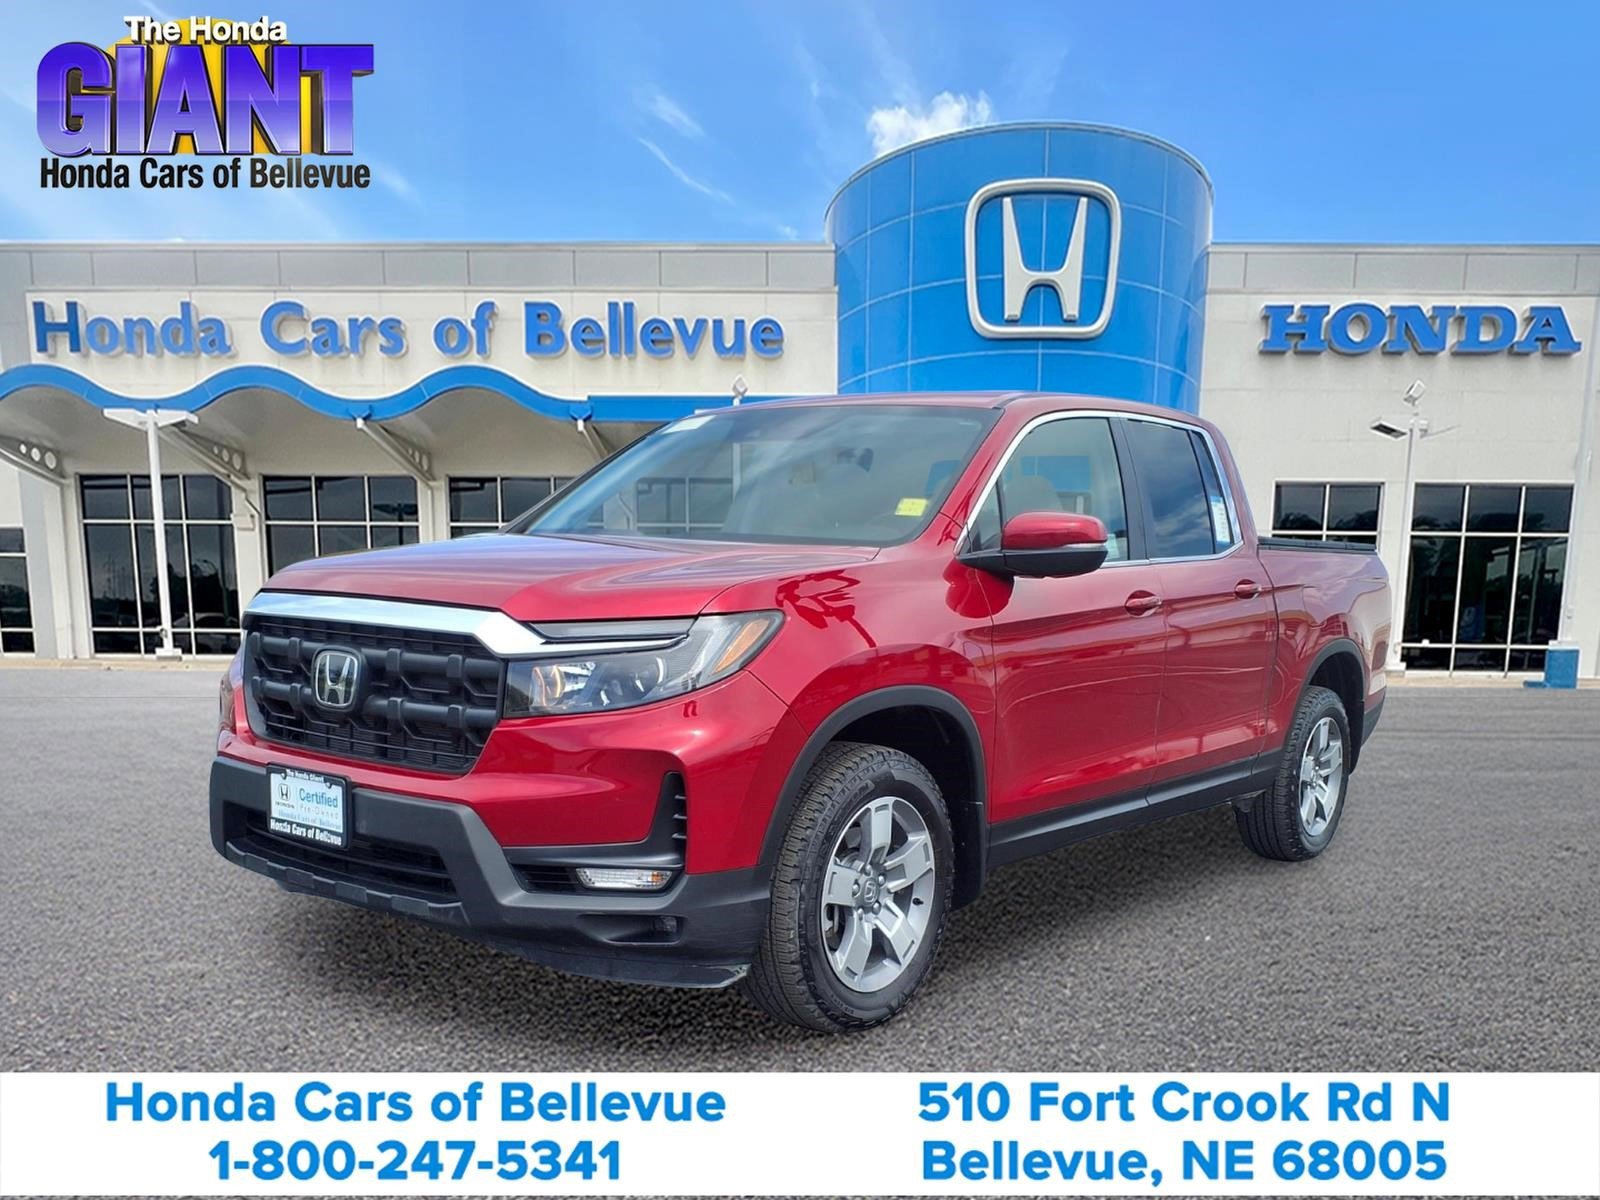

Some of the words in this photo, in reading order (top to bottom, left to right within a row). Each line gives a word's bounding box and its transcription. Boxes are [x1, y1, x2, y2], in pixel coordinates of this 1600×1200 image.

[33, 301, 233, 356] Honda
[260, 301, 407, 357] Cars
[432, 301, 497, 357] of
[523, 301, 785, 358] Bellevue
[1260, 303, 1582, 355] HONDA
[299, 788, 339, 808] Certified
[270, 819, 291, 833] Honda
[292, 824, 307, 837] Cars
